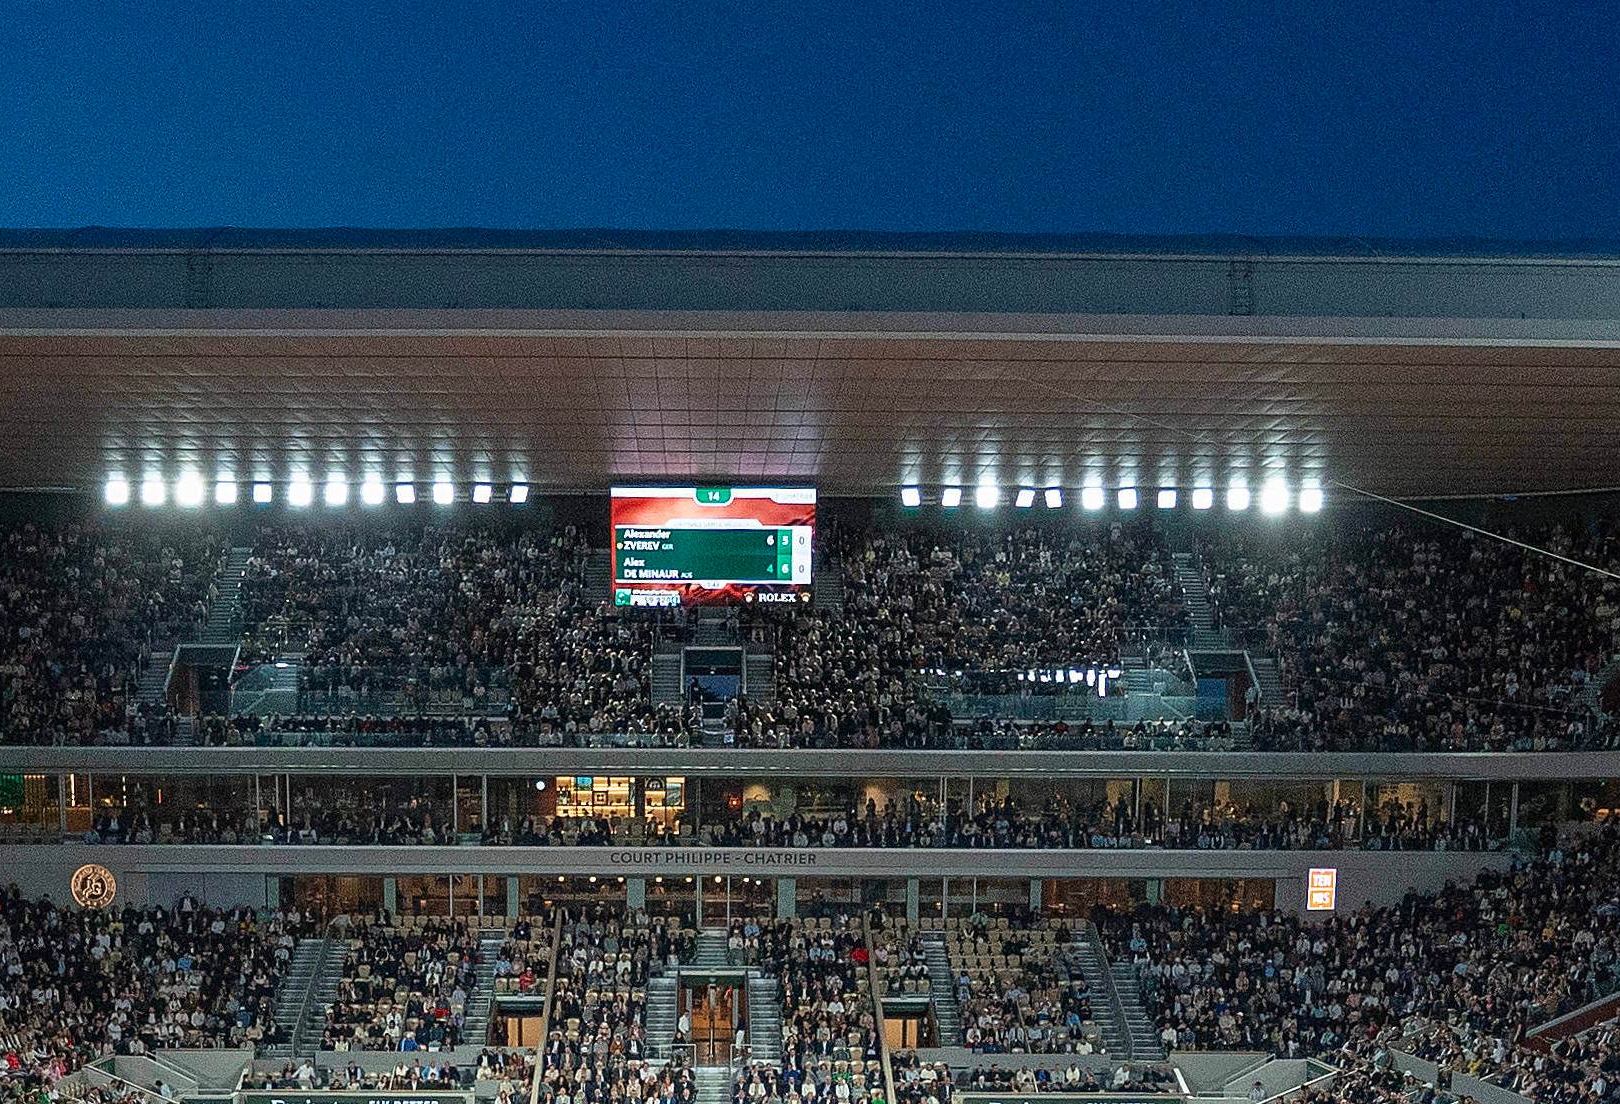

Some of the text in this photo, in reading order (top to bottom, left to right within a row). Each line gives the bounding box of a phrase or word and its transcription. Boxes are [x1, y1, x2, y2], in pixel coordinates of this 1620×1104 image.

[707, 491, 719, 500] 14
[623, 529, 671, 539] Alexander
[623, 541, 660, 550] ZVEREV
[623, 557, 645, 566] Alex
[623, 569, 637, 578] DE
[639, 569, 679, 578] MINAUR
[758, 592, 796, 602] ROLEX
[610, 852, 659, 864] COURT
[666, 852, 730, 864] PHILIPPE
[744, 852, 817, 864] CHATRIER
